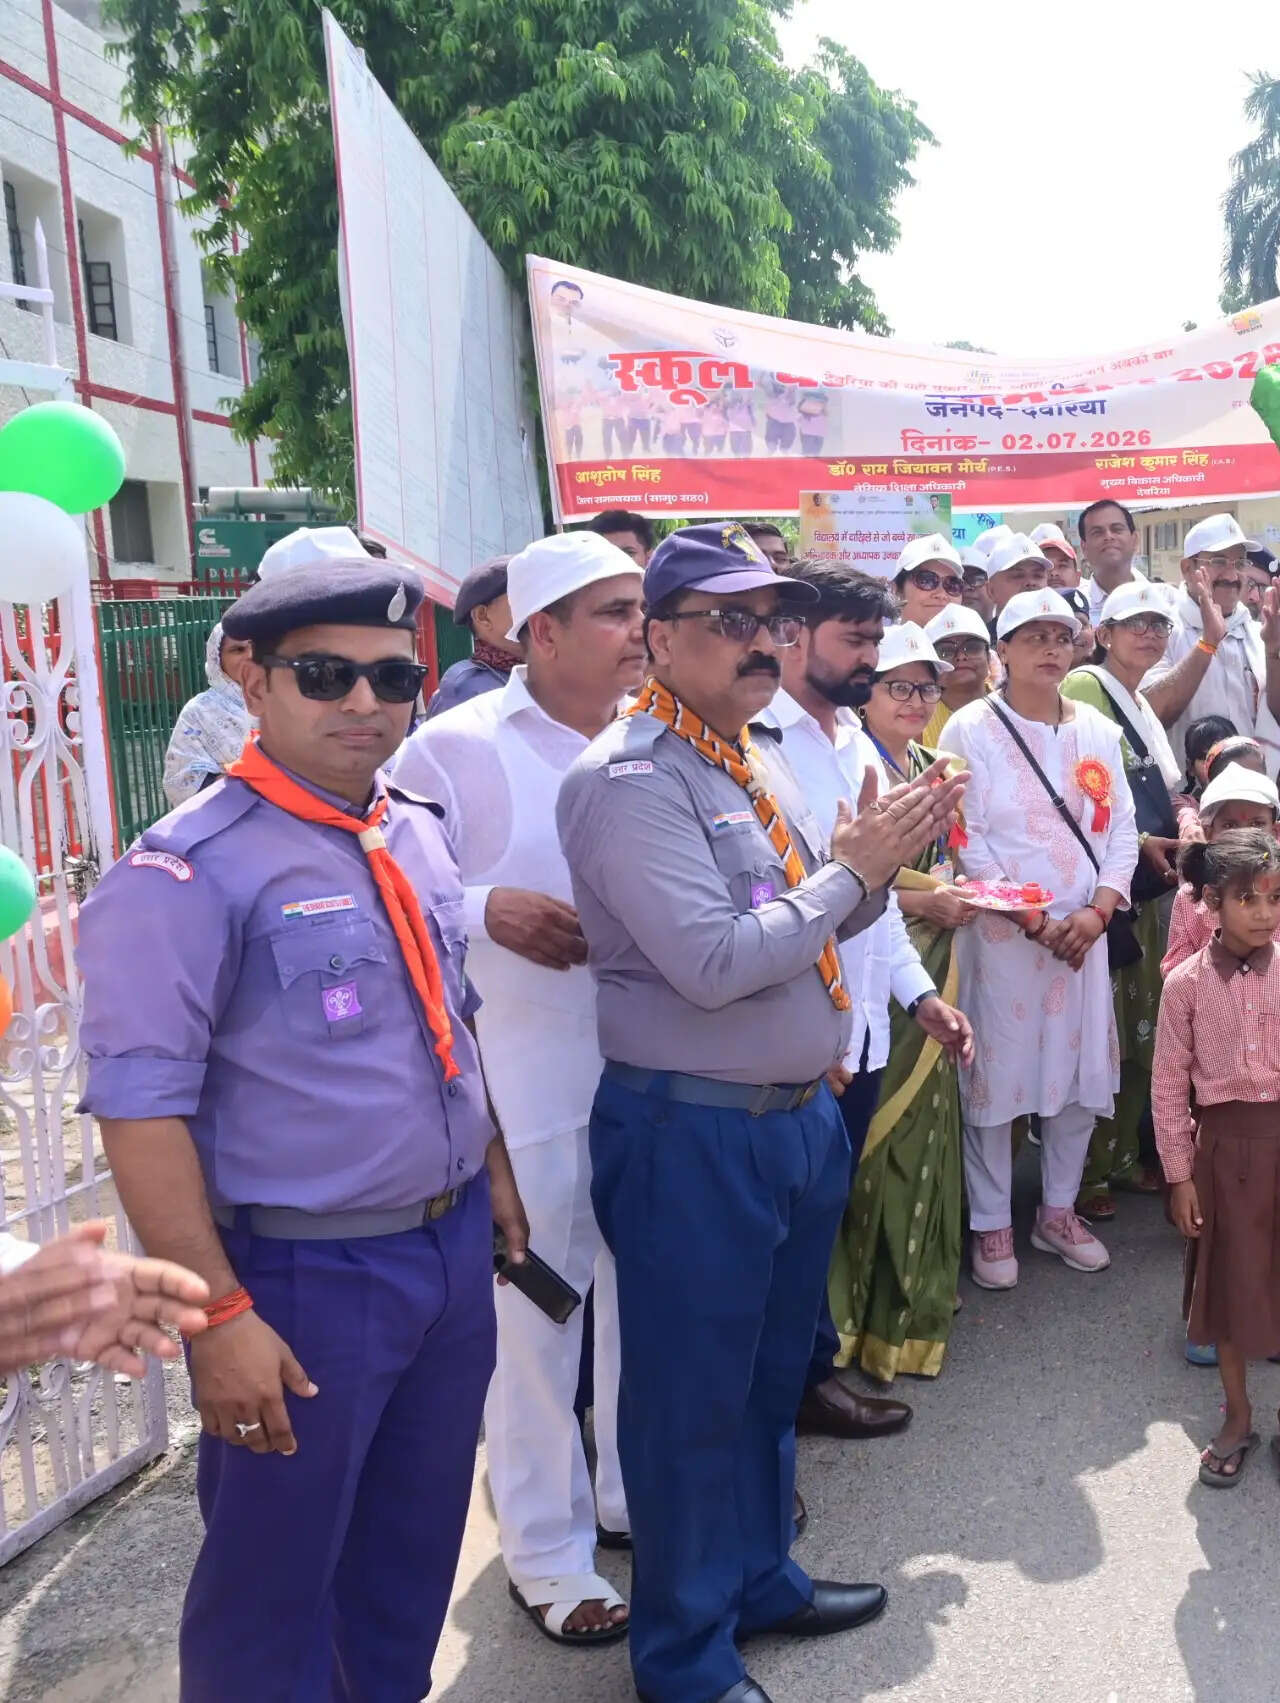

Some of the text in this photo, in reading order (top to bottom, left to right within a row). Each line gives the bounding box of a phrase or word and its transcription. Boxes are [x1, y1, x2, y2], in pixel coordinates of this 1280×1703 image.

[608, 350, 754, 405] स्कूल
[901, 428, 1151, 454] दिनांक- 02.07.2026
[864, 463, 888, 476] राम
[893, 459, 952, 475] जियावन
[958, 458, 988, 473] मौर्य
[1095, 450, 1209, 471] राजेश कुमार सिंह
[576, 465, 661, 486] आशुतोष सिंह
[1101, 472, 1205, 489] मुख्य विकास अधिकारी
[918, 480, 966, 491] अधिकारी
[1137, 487, 1170, 496] देवरिया
[814, 530, 839, 542] विद्यालय
[873, 530, 880, 542] से
[881, 530, 890, 542] जो
[892, 531, 905, 541] बच्चे
[839, 547, 851, 560] और
[853, 551, 880, 560] अध्यापक
